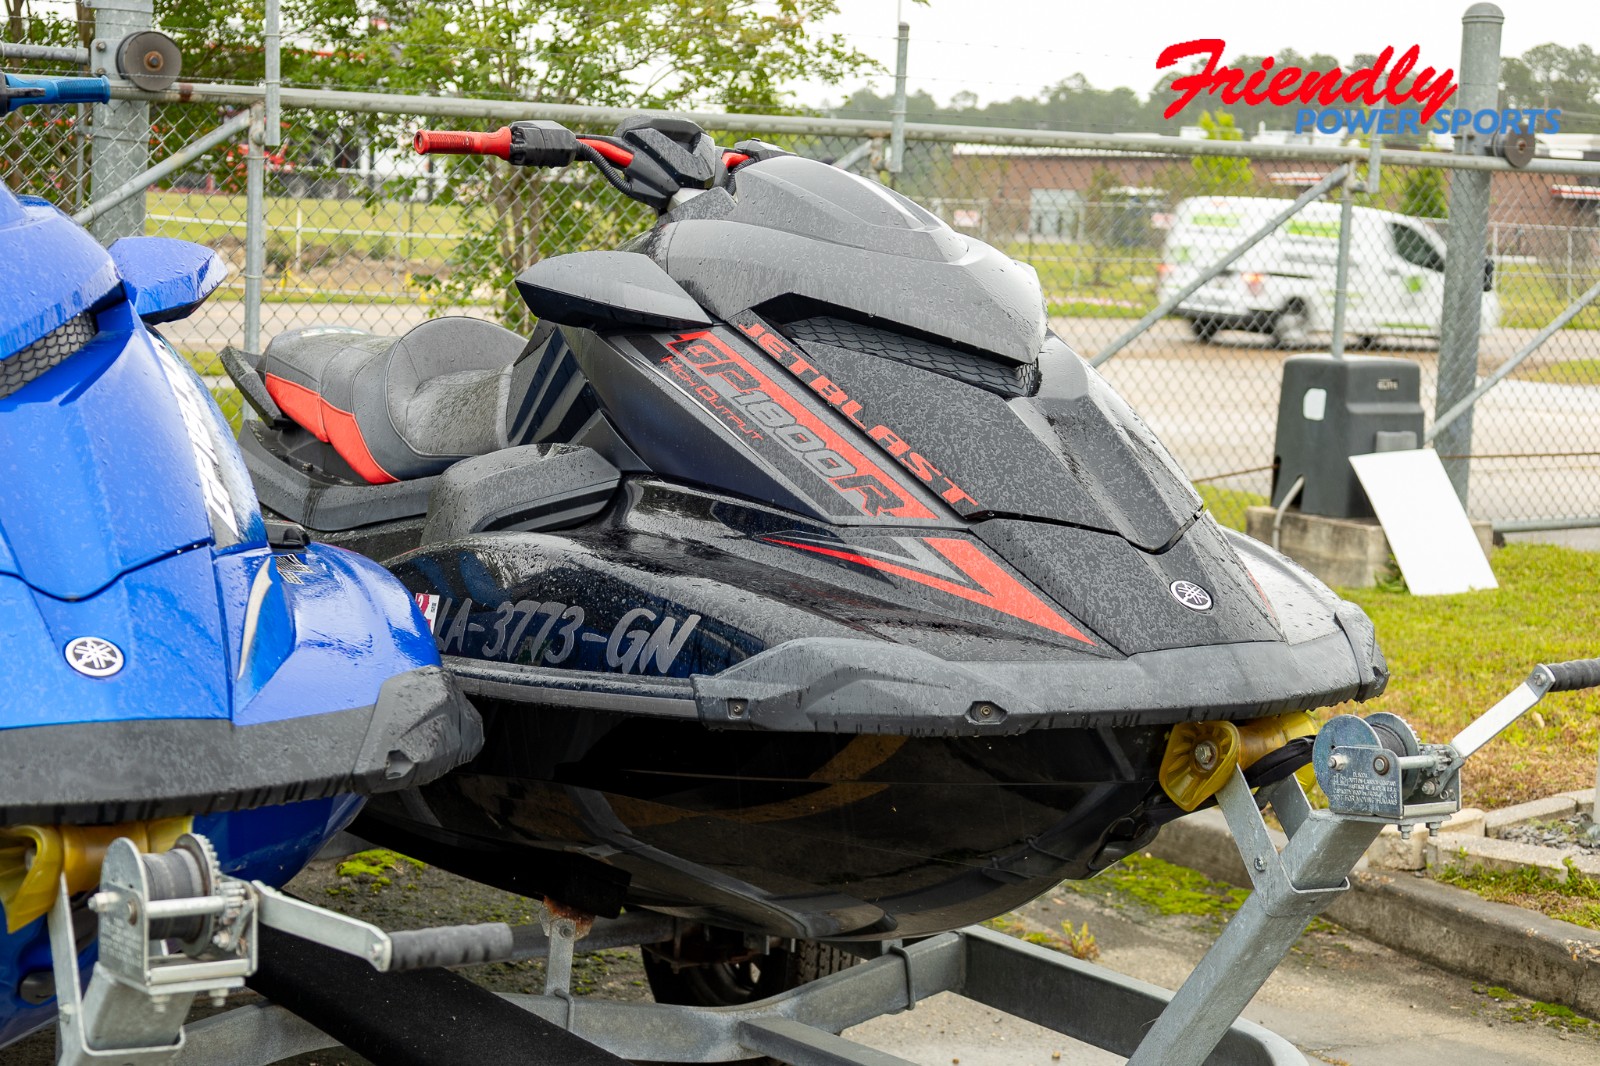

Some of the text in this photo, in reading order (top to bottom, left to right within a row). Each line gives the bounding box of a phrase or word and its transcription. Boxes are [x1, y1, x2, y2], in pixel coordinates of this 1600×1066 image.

[666, 337, 904, 517] GP1800R
[695, 385, 764, 440] OUTPUT
[738, 323, 979, 506] JETBLAST
[434, 597, 702, 674] LA-3773-GN
